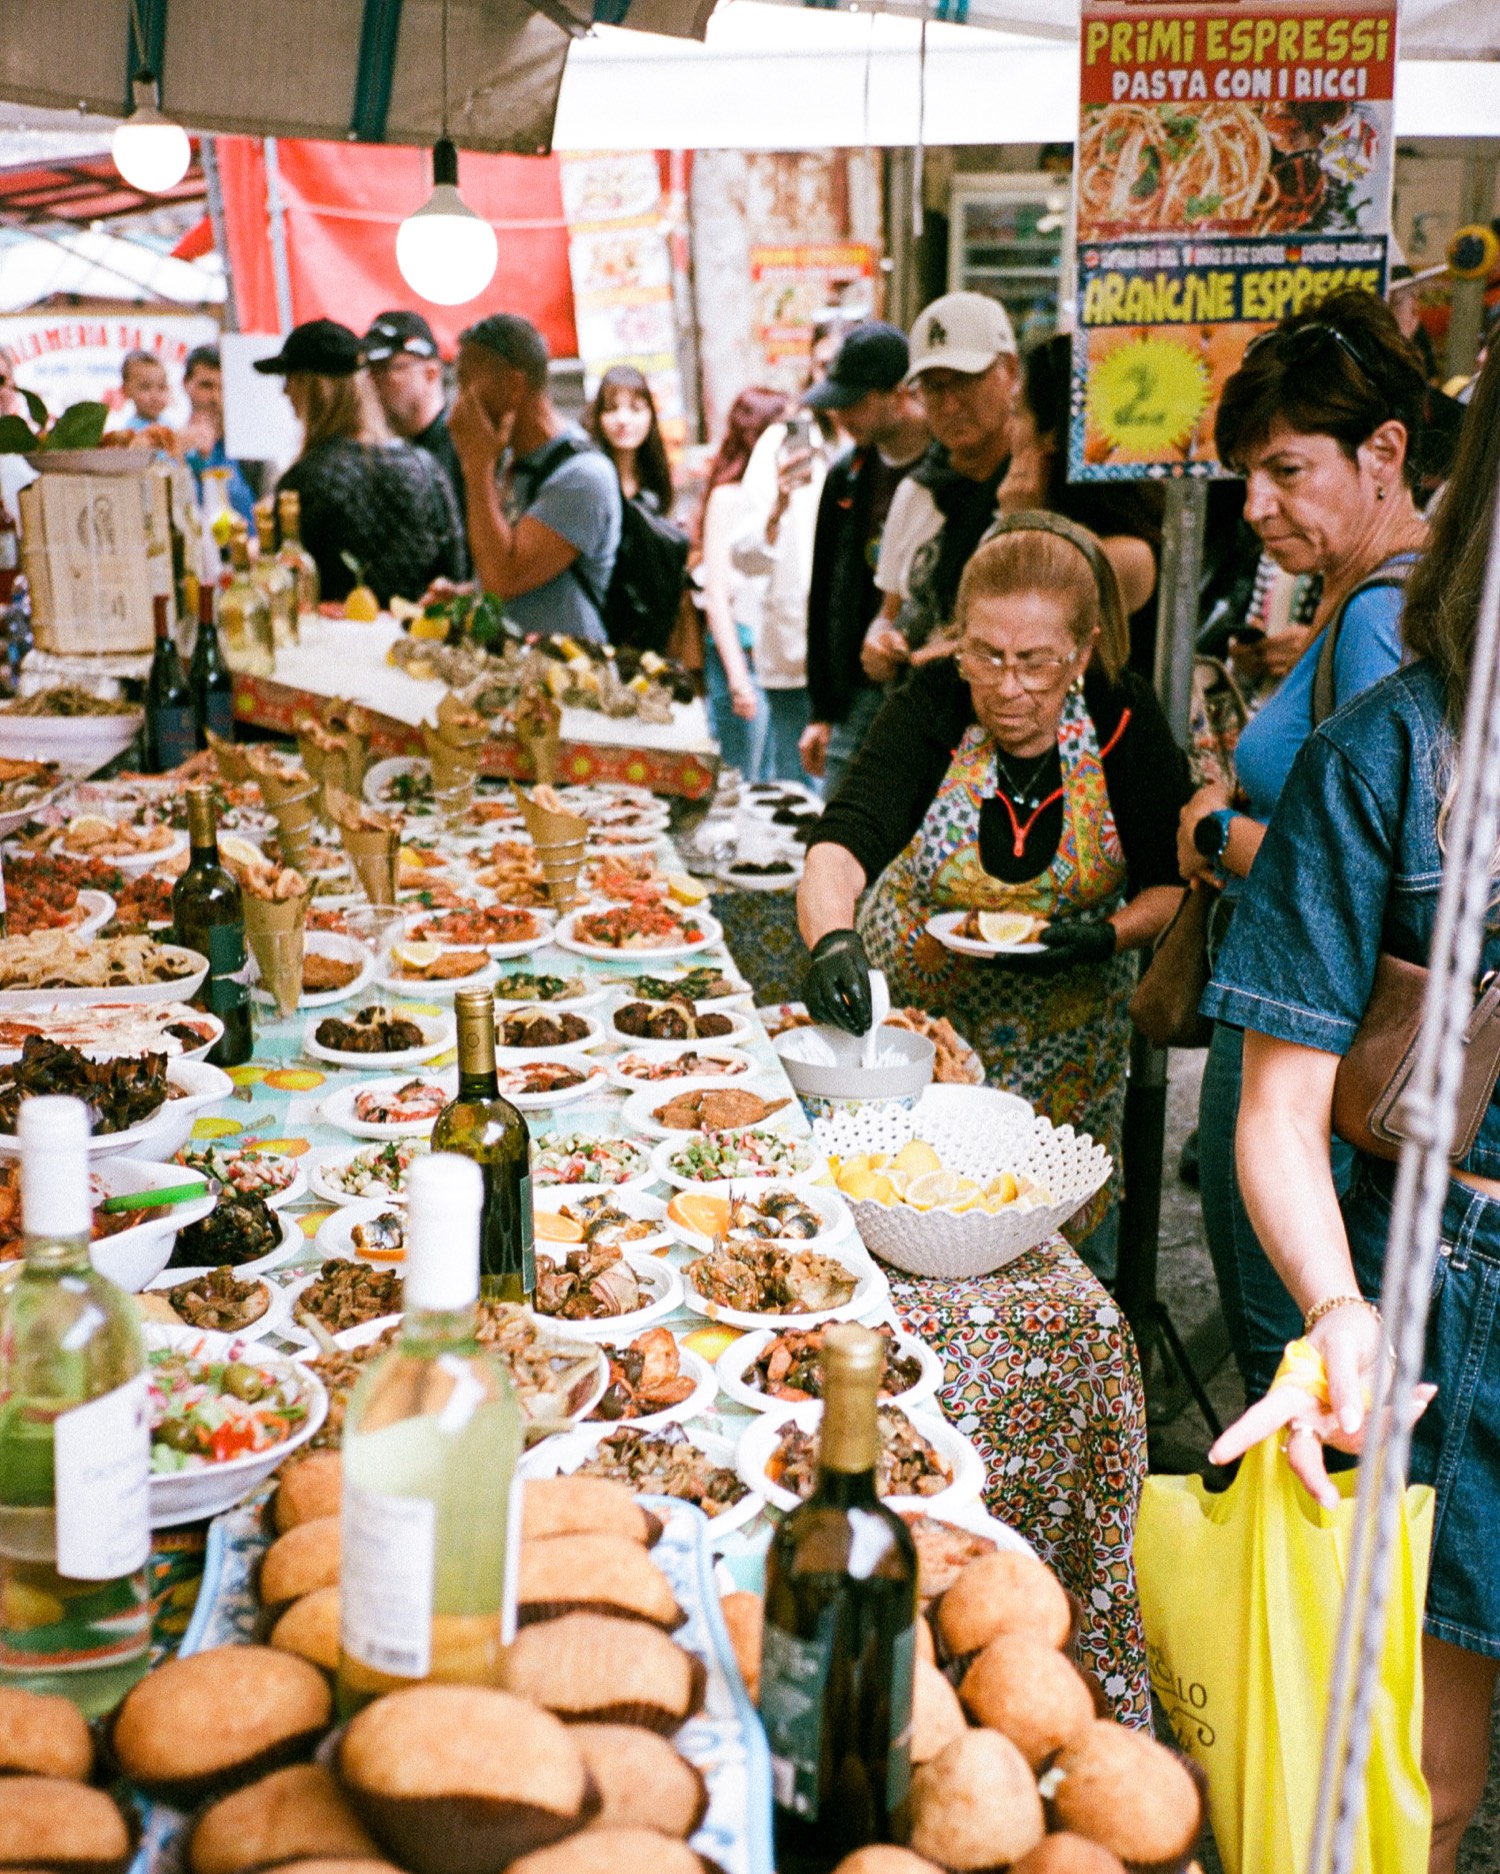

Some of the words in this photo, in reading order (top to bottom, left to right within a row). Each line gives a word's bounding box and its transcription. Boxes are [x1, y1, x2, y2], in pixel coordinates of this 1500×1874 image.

[1112, 69, 1208, 100] PASTA
[1213, 68, 1272, 99] CON
[1278, 68, 1288, 97] I
[1294, 67, 1368, 97] RICCI
[1081, 270, 1235, 325] ARANCINE
[1113, 364, 1166, 427] 2
